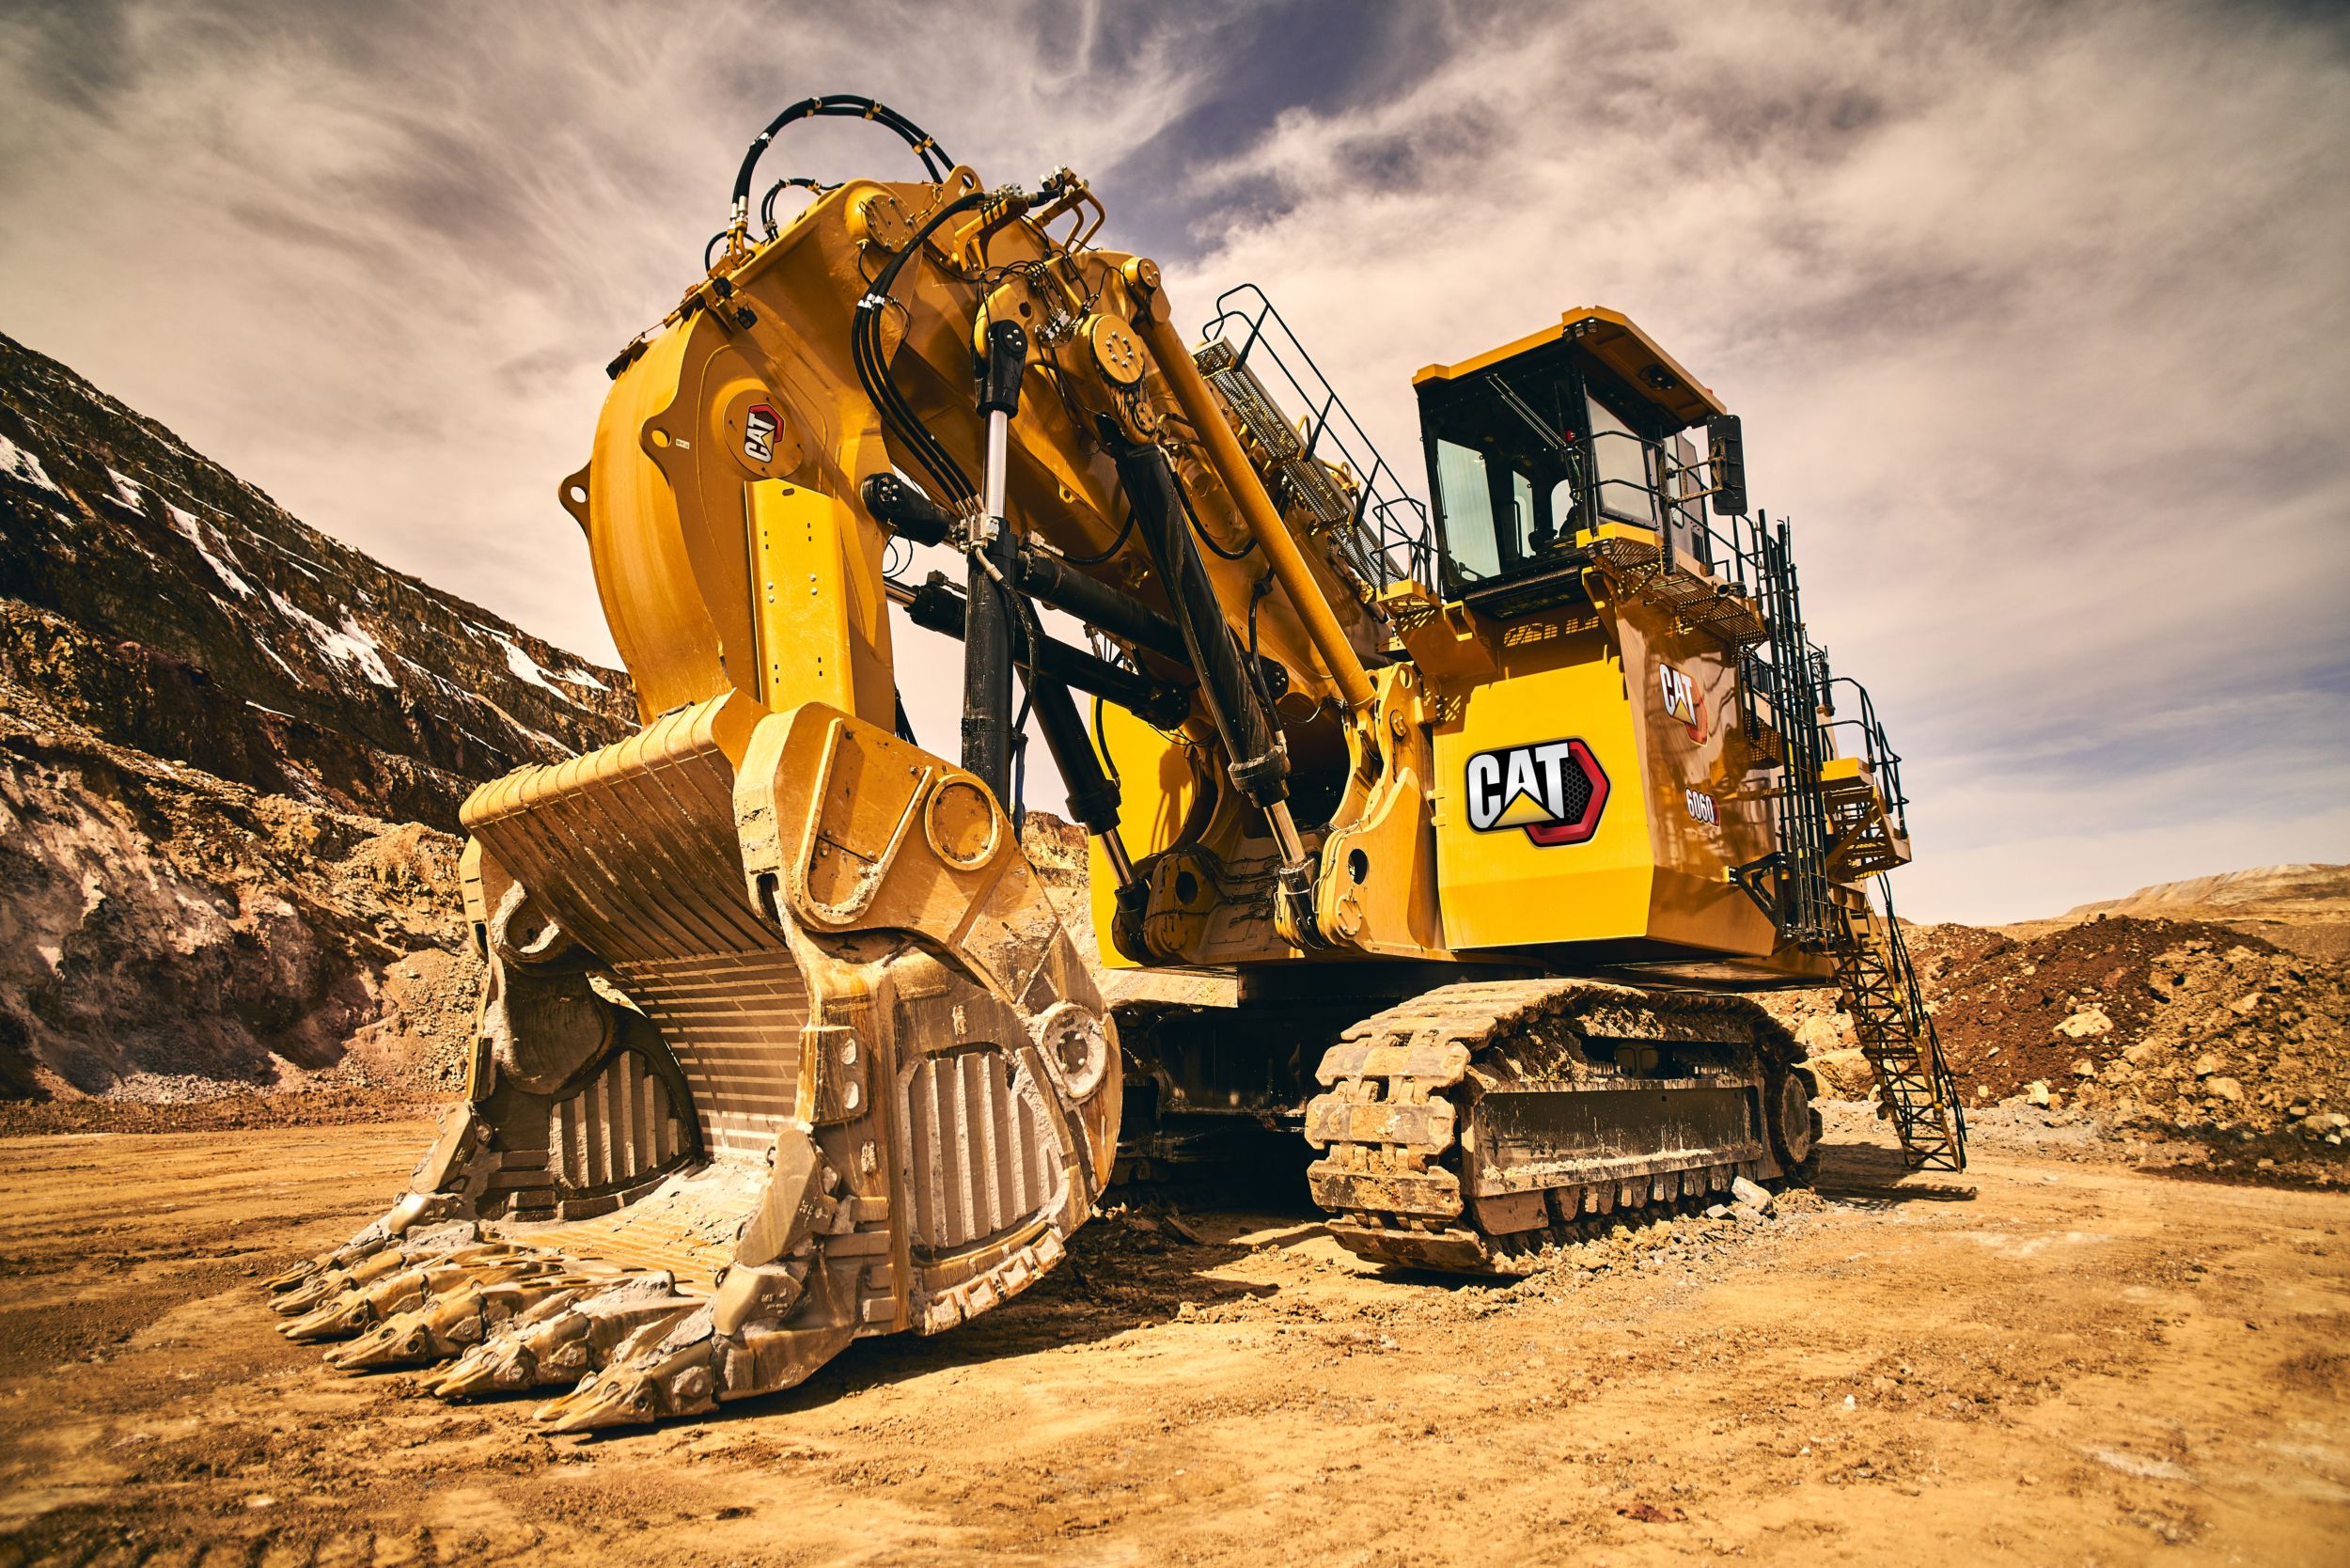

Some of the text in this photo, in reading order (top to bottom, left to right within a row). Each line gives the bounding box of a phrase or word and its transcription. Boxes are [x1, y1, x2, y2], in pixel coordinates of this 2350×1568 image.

[744, 413, 776, 463] CAT
[1659, 664, 1697, 726] CAT
[1468, 743, 1569, 828] CAT
[1685, 788, 1715, 823] 6060
